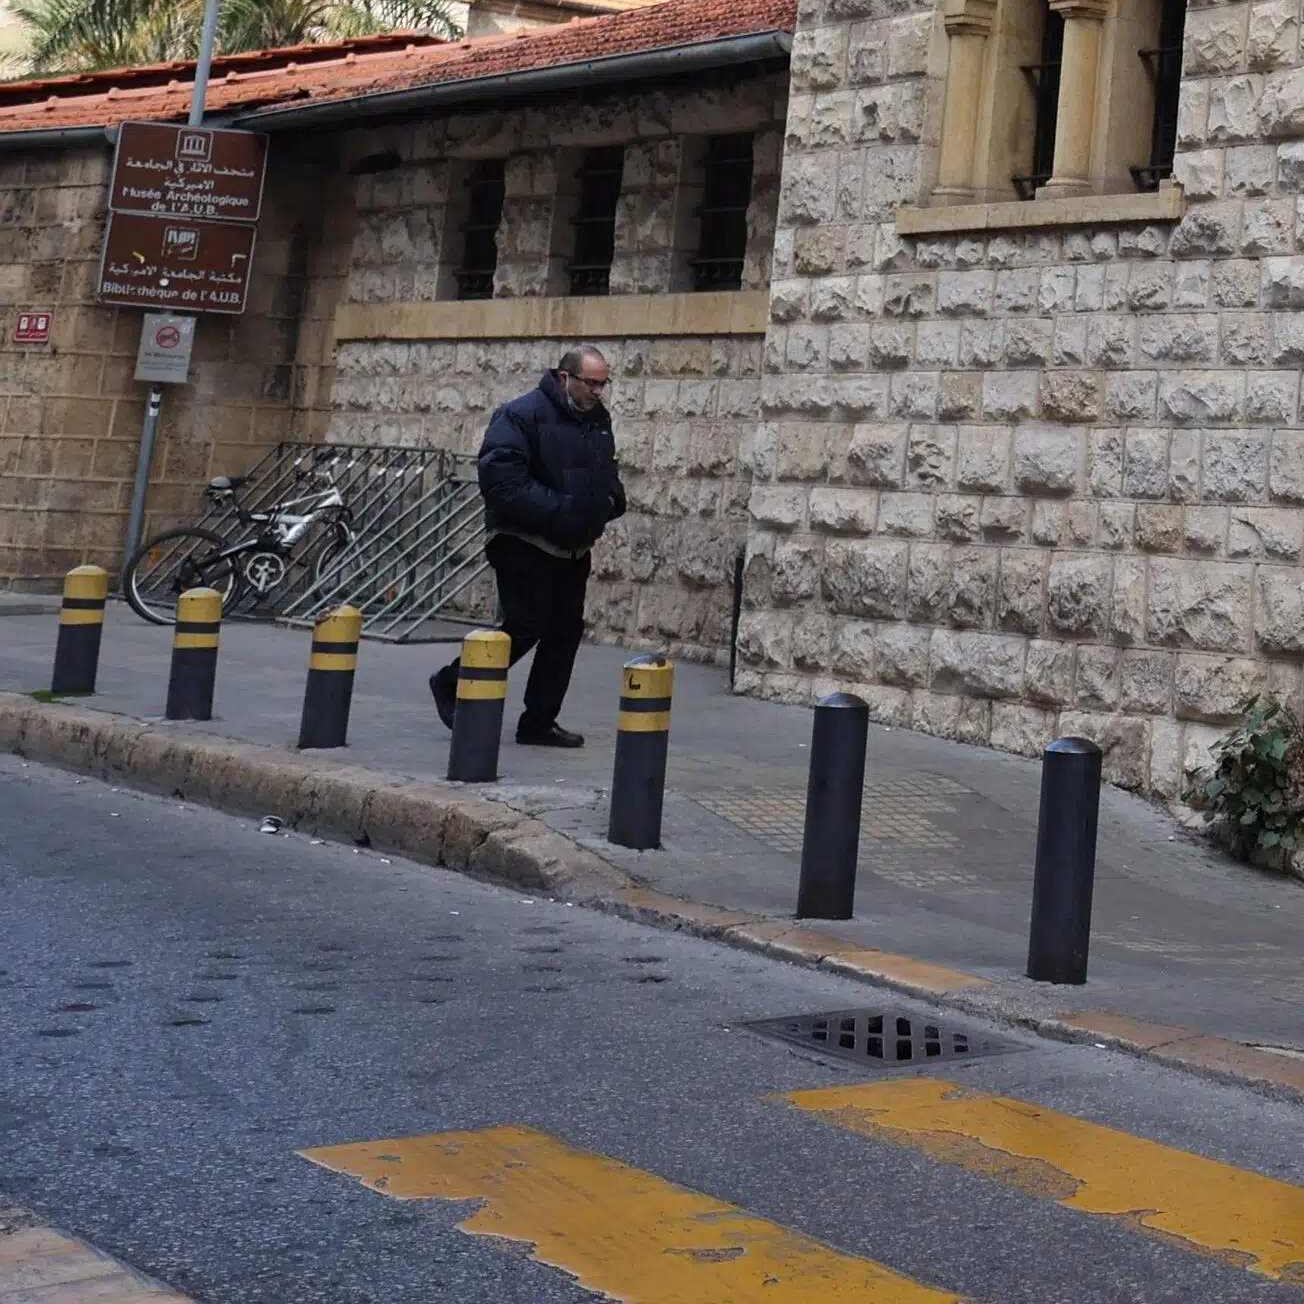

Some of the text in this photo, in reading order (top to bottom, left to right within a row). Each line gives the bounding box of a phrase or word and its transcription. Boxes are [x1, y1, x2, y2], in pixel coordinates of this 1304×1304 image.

[125, 156, 173, 171] الجامعة
[166, 190, 249, 207] Archéologique
[151, 202, 166, 212] de
[182, 289, 198, 300] de
